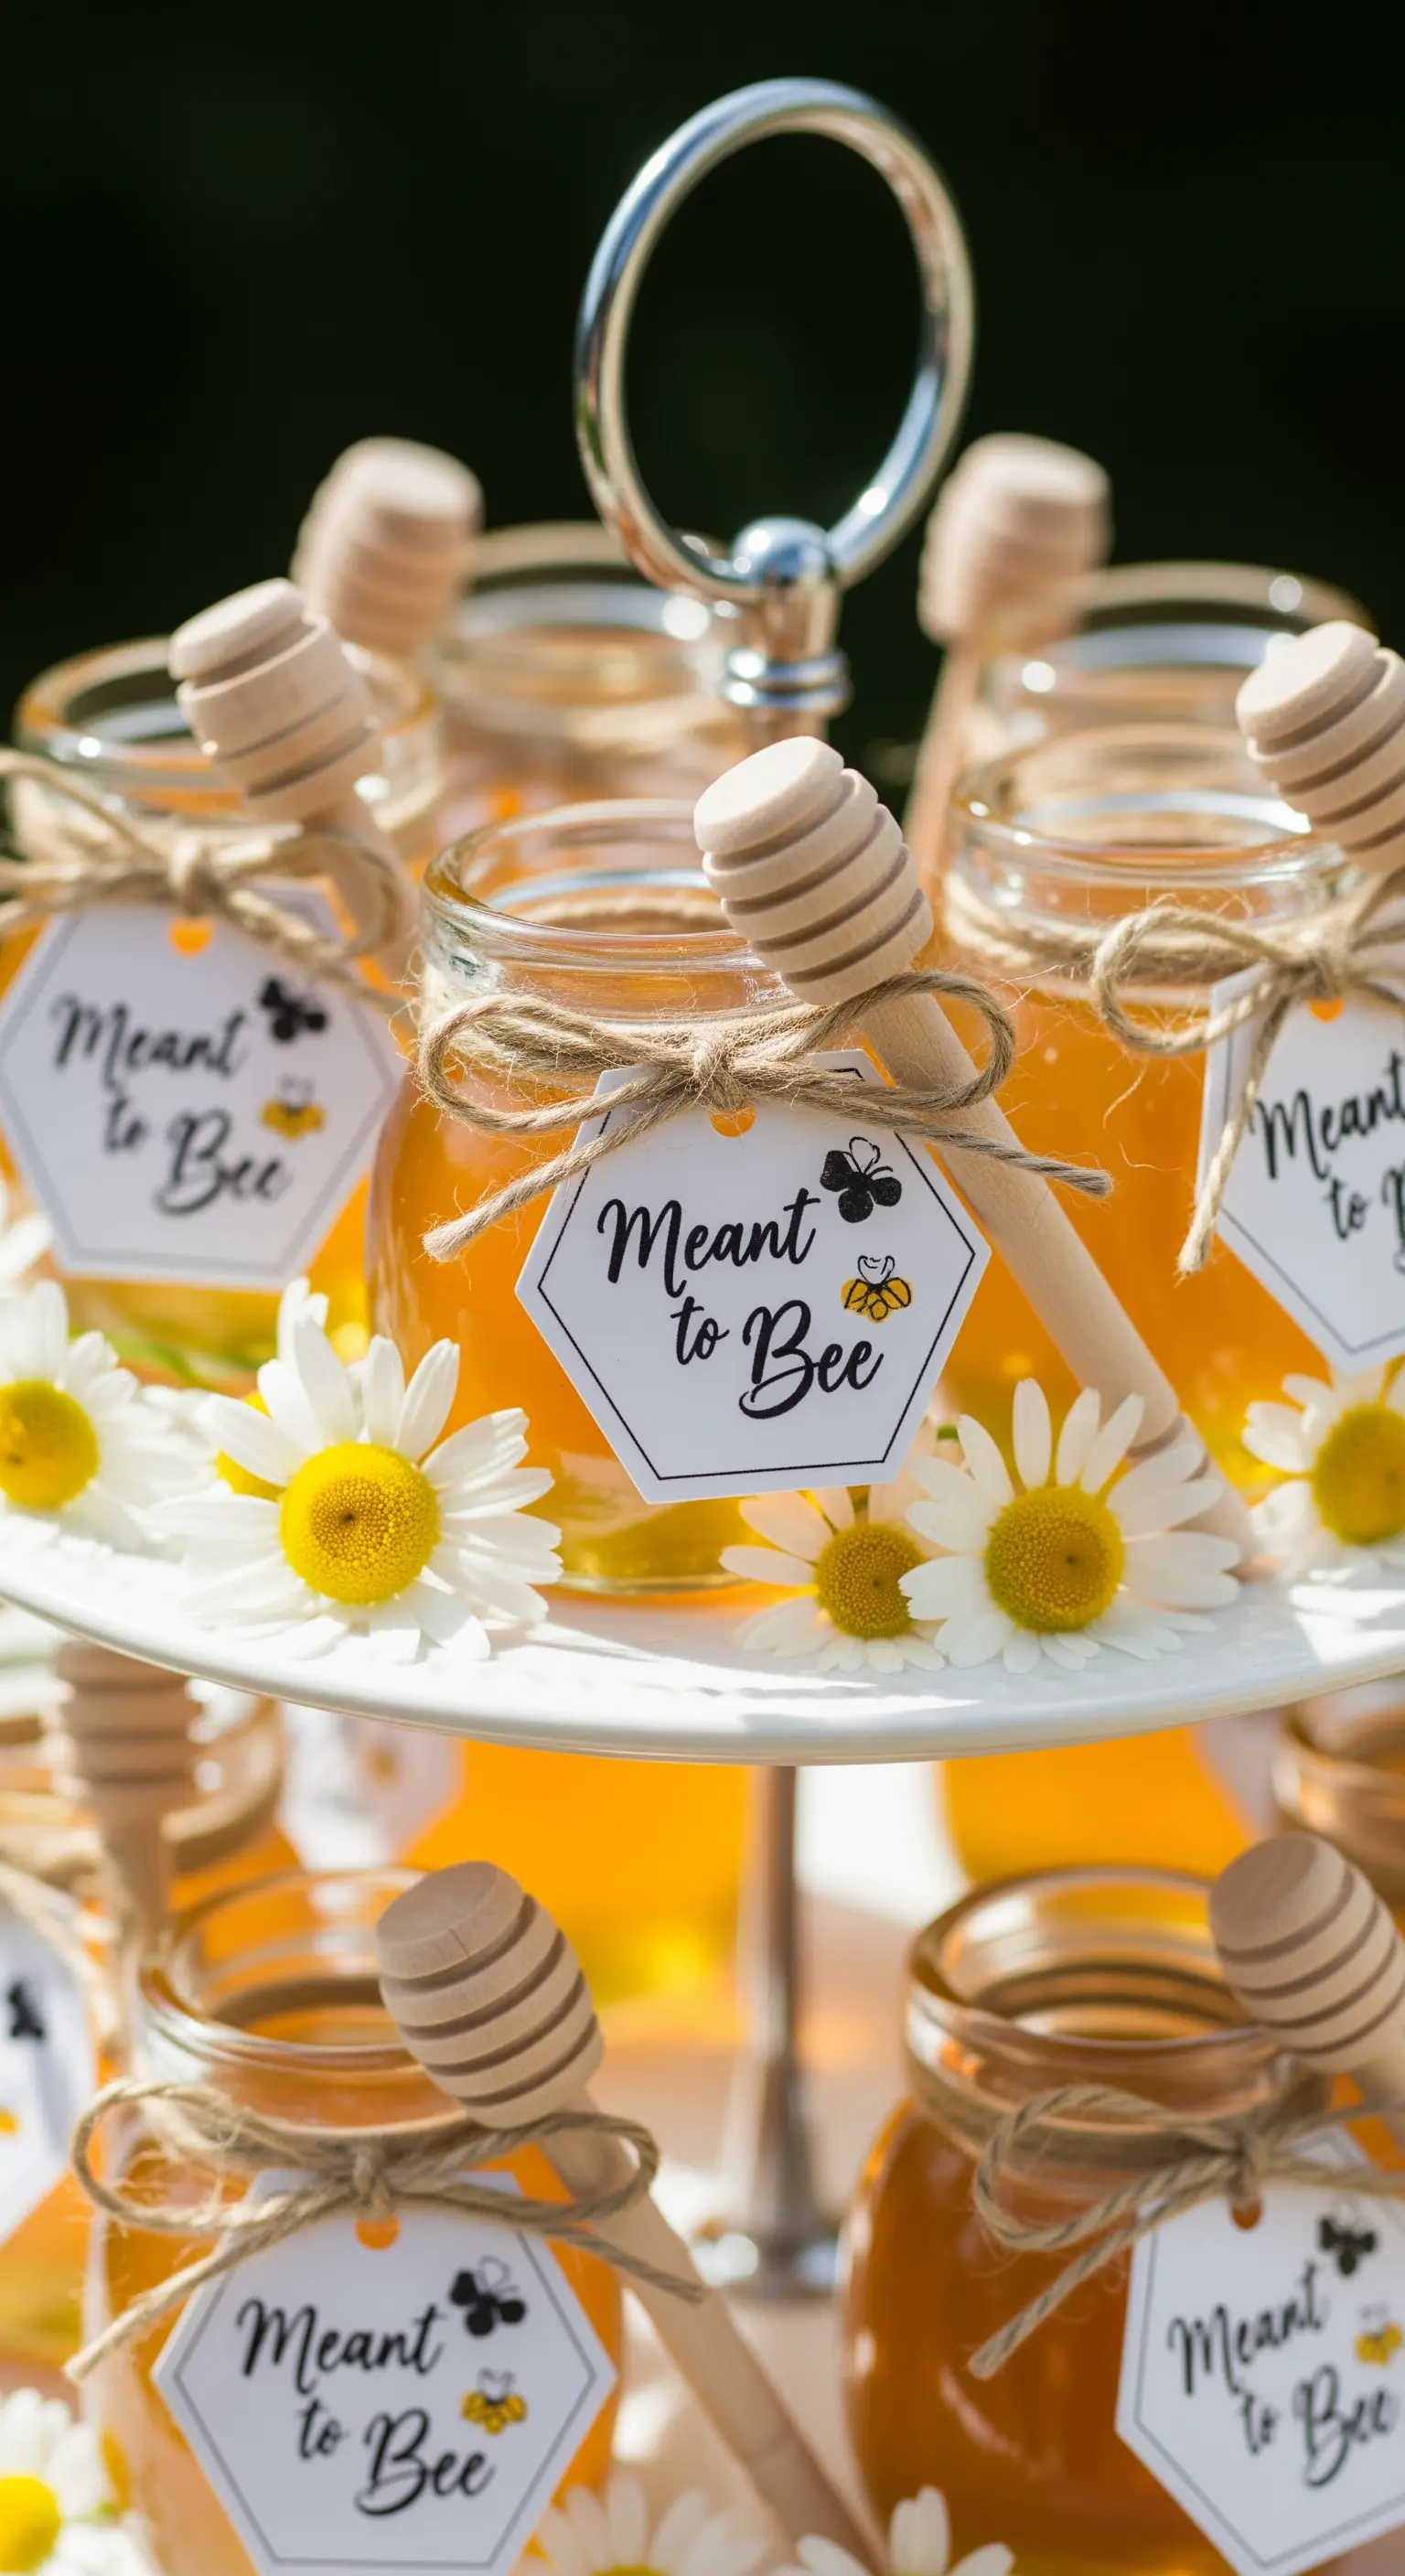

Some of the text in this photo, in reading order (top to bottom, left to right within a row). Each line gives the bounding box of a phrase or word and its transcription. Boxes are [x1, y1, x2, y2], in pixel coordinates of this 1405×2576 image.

[51, 992, 247, 1092] Meant
[103, 1096, 291, 1218] to Bee
[1249, 1051, 1405, 1183] Meant
[596, 1187, 821, 1298] Meant
[1324, 1176, 1370, 1240] to
[670, 1296, 885, 1420] to Bee
[235, 2297, 448, 2395] Meant
[1168, 2259, 1325, 2396] Meant
[295, 2397, 495, 2517] to Bee
[1238, 2365, 1398, 2489] to Bee
